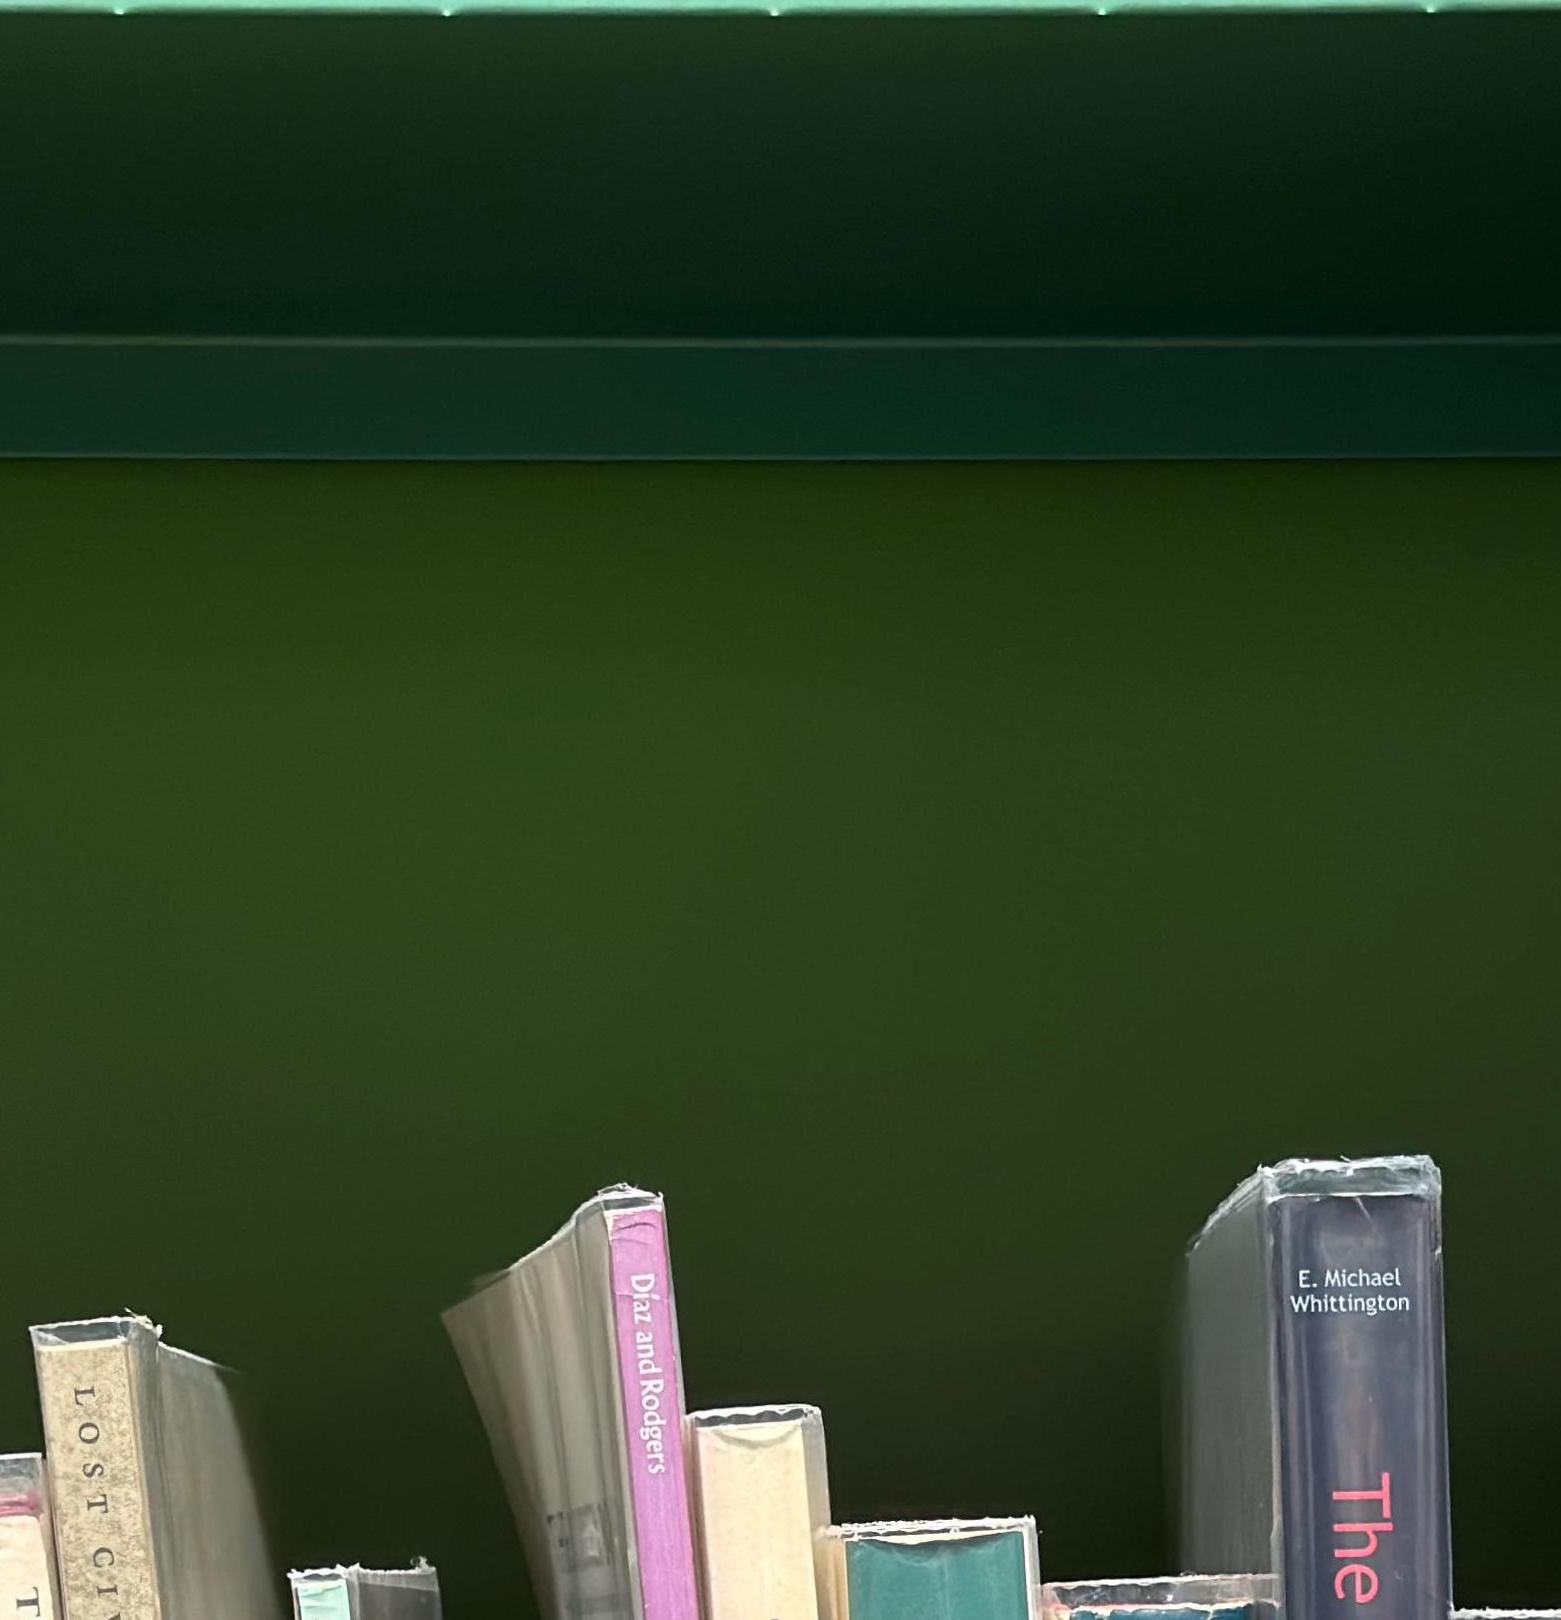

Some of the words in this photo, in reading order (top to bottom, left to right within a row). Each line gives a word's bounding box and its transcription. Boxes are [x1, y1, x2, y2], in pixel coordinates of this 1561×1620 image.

[630, 1273, 658, 1324] Díaz
[1298, 1269, 1318, 1289] E.
[1325, 1268, 1402, 1288] Michael
[1290, 1294, 1410, 1316] Whittington
[637, 1330, 660, 1375] and
[640, 1378, 665, 1474] Rodgers
[1332, 1472, 1393, 1604] The
